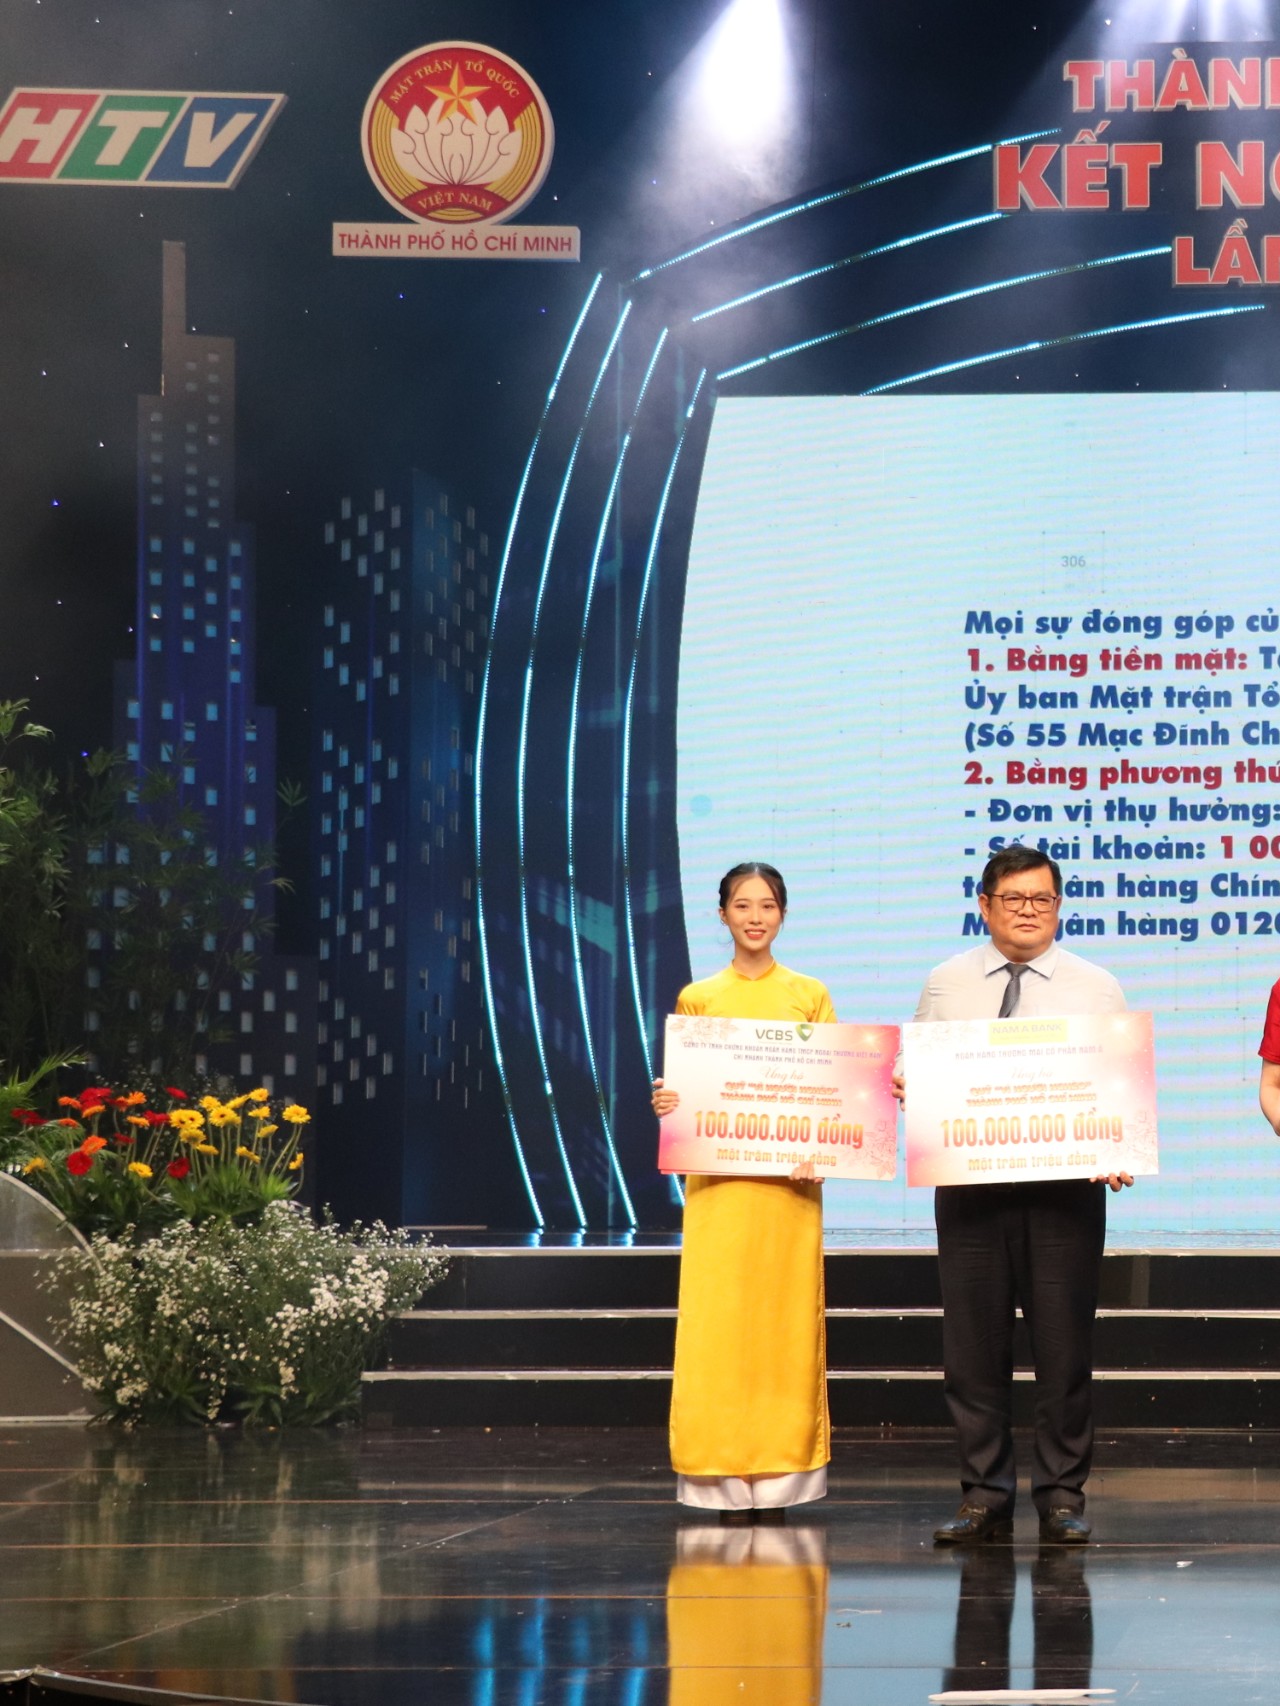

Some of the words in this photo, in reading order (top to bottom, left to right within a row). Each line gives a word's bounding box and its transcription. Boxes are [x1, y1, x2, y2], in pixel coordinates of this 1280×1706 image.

[390, 76, 413, 104] MẶT
[415, 60, 453, 80] TRẬN
[465, 59, 483, 73] TỔ
[487, 67, 520, 99] QUỐC
[0, 107, 257, 168] HTV
[993, 120, 1162, 211] KẾT
[418, 191, 454, 209] VIỆT
[459, 192, 492, 211] NAM
[339, 230, 401, 250] THÀNH
[407, 229, 445, 250] PHỐ
[451, 229, 478, 251] HỒ
[484, 231, 517, 251] CHÍ
[523, 237, 572, 252] MINH
[1060, 555, 1086, 568] 306
[963, 609, 1024, 641] Mọi
[1035, 616, 1073, 641] sự
[1081, 608, 1163, 641] đóng
[1173, 609, 1235, 640] góp
[967, 648, 995, 672] 1.
[1007, 645, 1088, 678] Bằng
[1099, 645, 1163, 671] tiền
[1175, 647, 1247, 676] mặt:
[964, 678, 1008, 716] Ủy
[1018, 683, 1079, 710] ban
[1089, 684, 1154, 715] Mặt
[1163, 684, 1233, 715] trận
[1243, 680, 1280, 708] Tổ
[964, 721, 1015, 754] (Số
[1026, 722, 1067, 748] 55
[1077, 722, 1143, 753] Mạc
[964, 760, 994, 785] 2.
[1006, 757, 1088, 791] Bằng
[1099, 758, 1223, 791] phương
[987, 798, 1053, 823] Đơn
[1063, 798, 1093, 829] vị
[1103, 796, 1157, 829] thụ
[1037, 836, 1081, 861] tài
[1092, 834, 1206, 861] khoản:
[1220, 835, 1233, 859] 1
[1116, 872, 1199, 905] hàng
[1117, 910, 1199, 943] hàng
[755, 1028, 793, 1041] VCBS
[695, 1110, 811, 1143] 100.000.000
[817, 1113, 863, 1149] đồng
[940, 1113, 1066, 1148] 100.000.000
[1073, 1107, 1123, 1143] đồng
